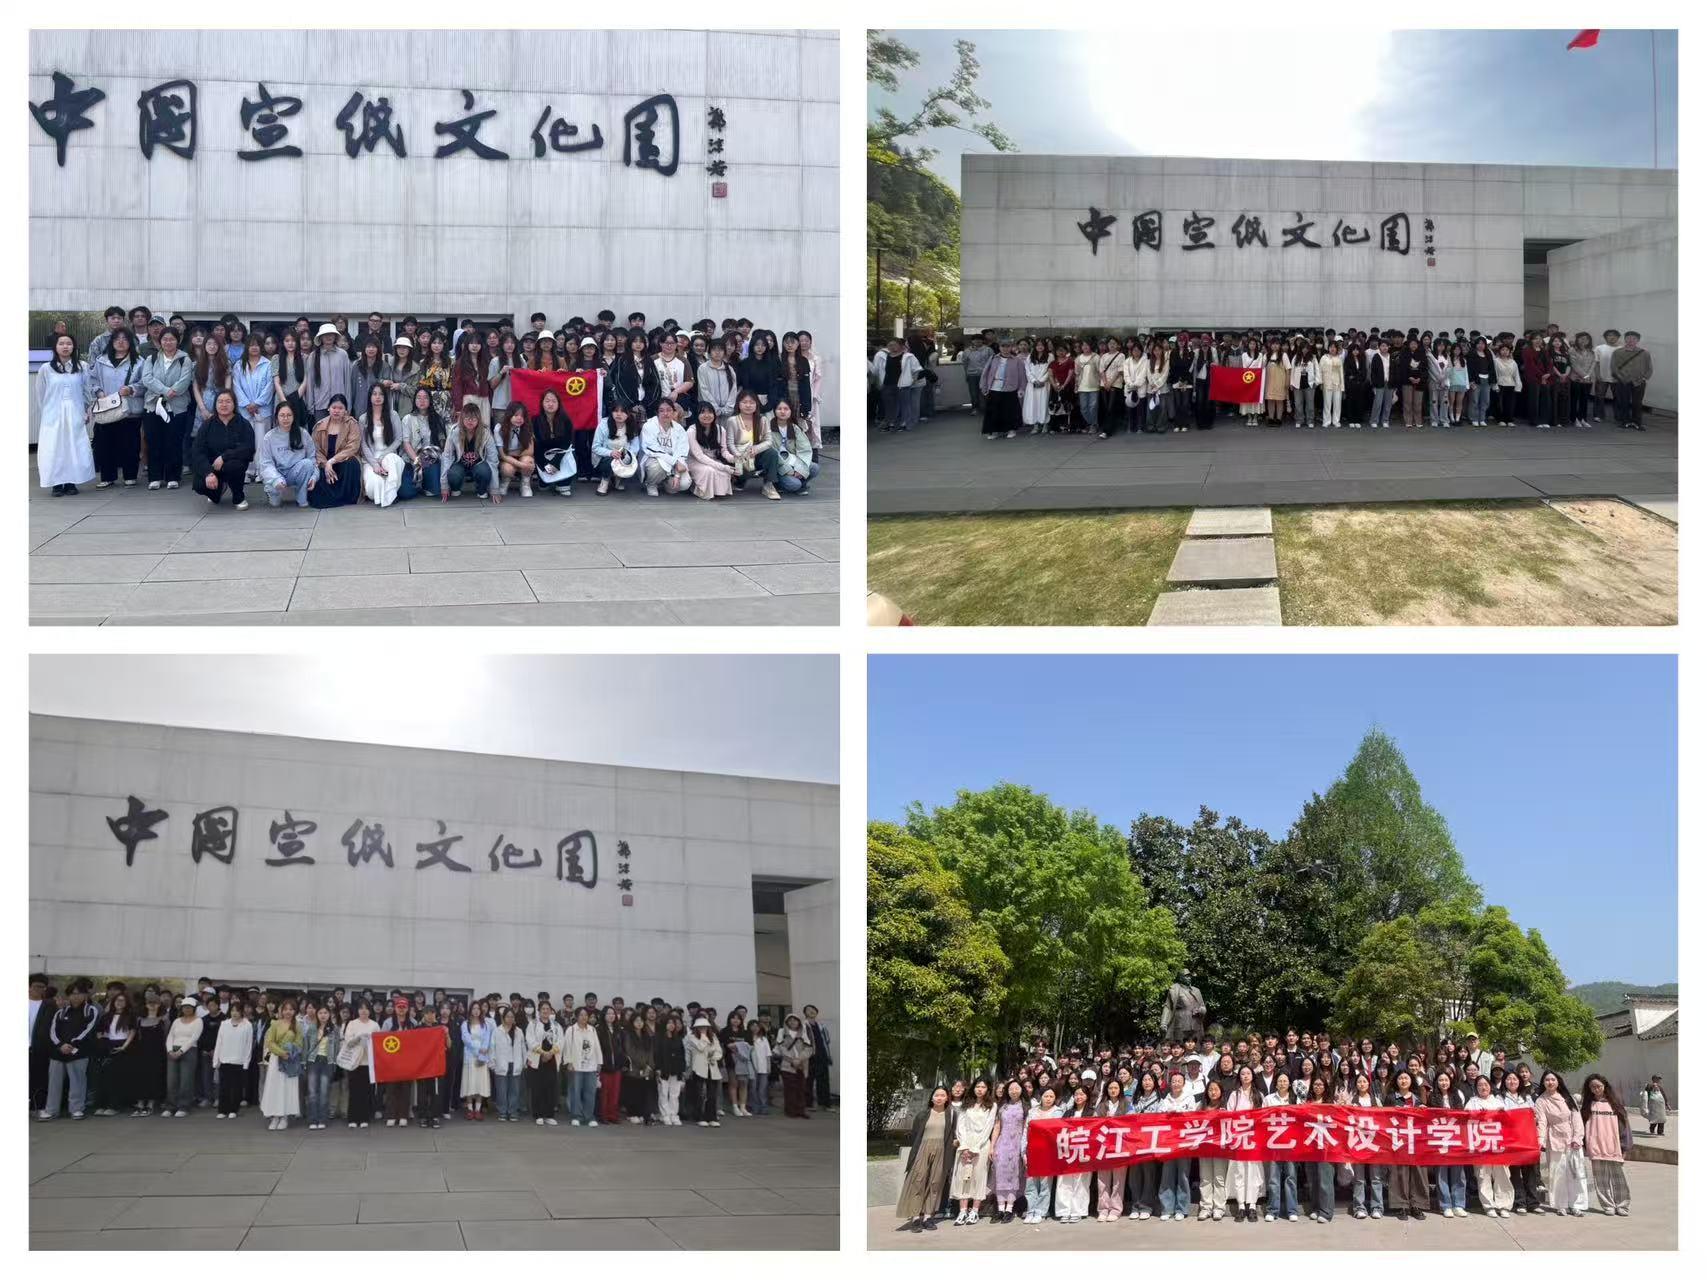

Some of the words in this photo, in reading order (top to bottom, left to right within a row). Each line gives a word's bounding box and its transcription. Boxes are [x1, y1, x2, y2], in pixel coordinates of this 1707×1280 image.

[1056, 1112, 1505, 1164] 皖江工学院艺术设计学院
